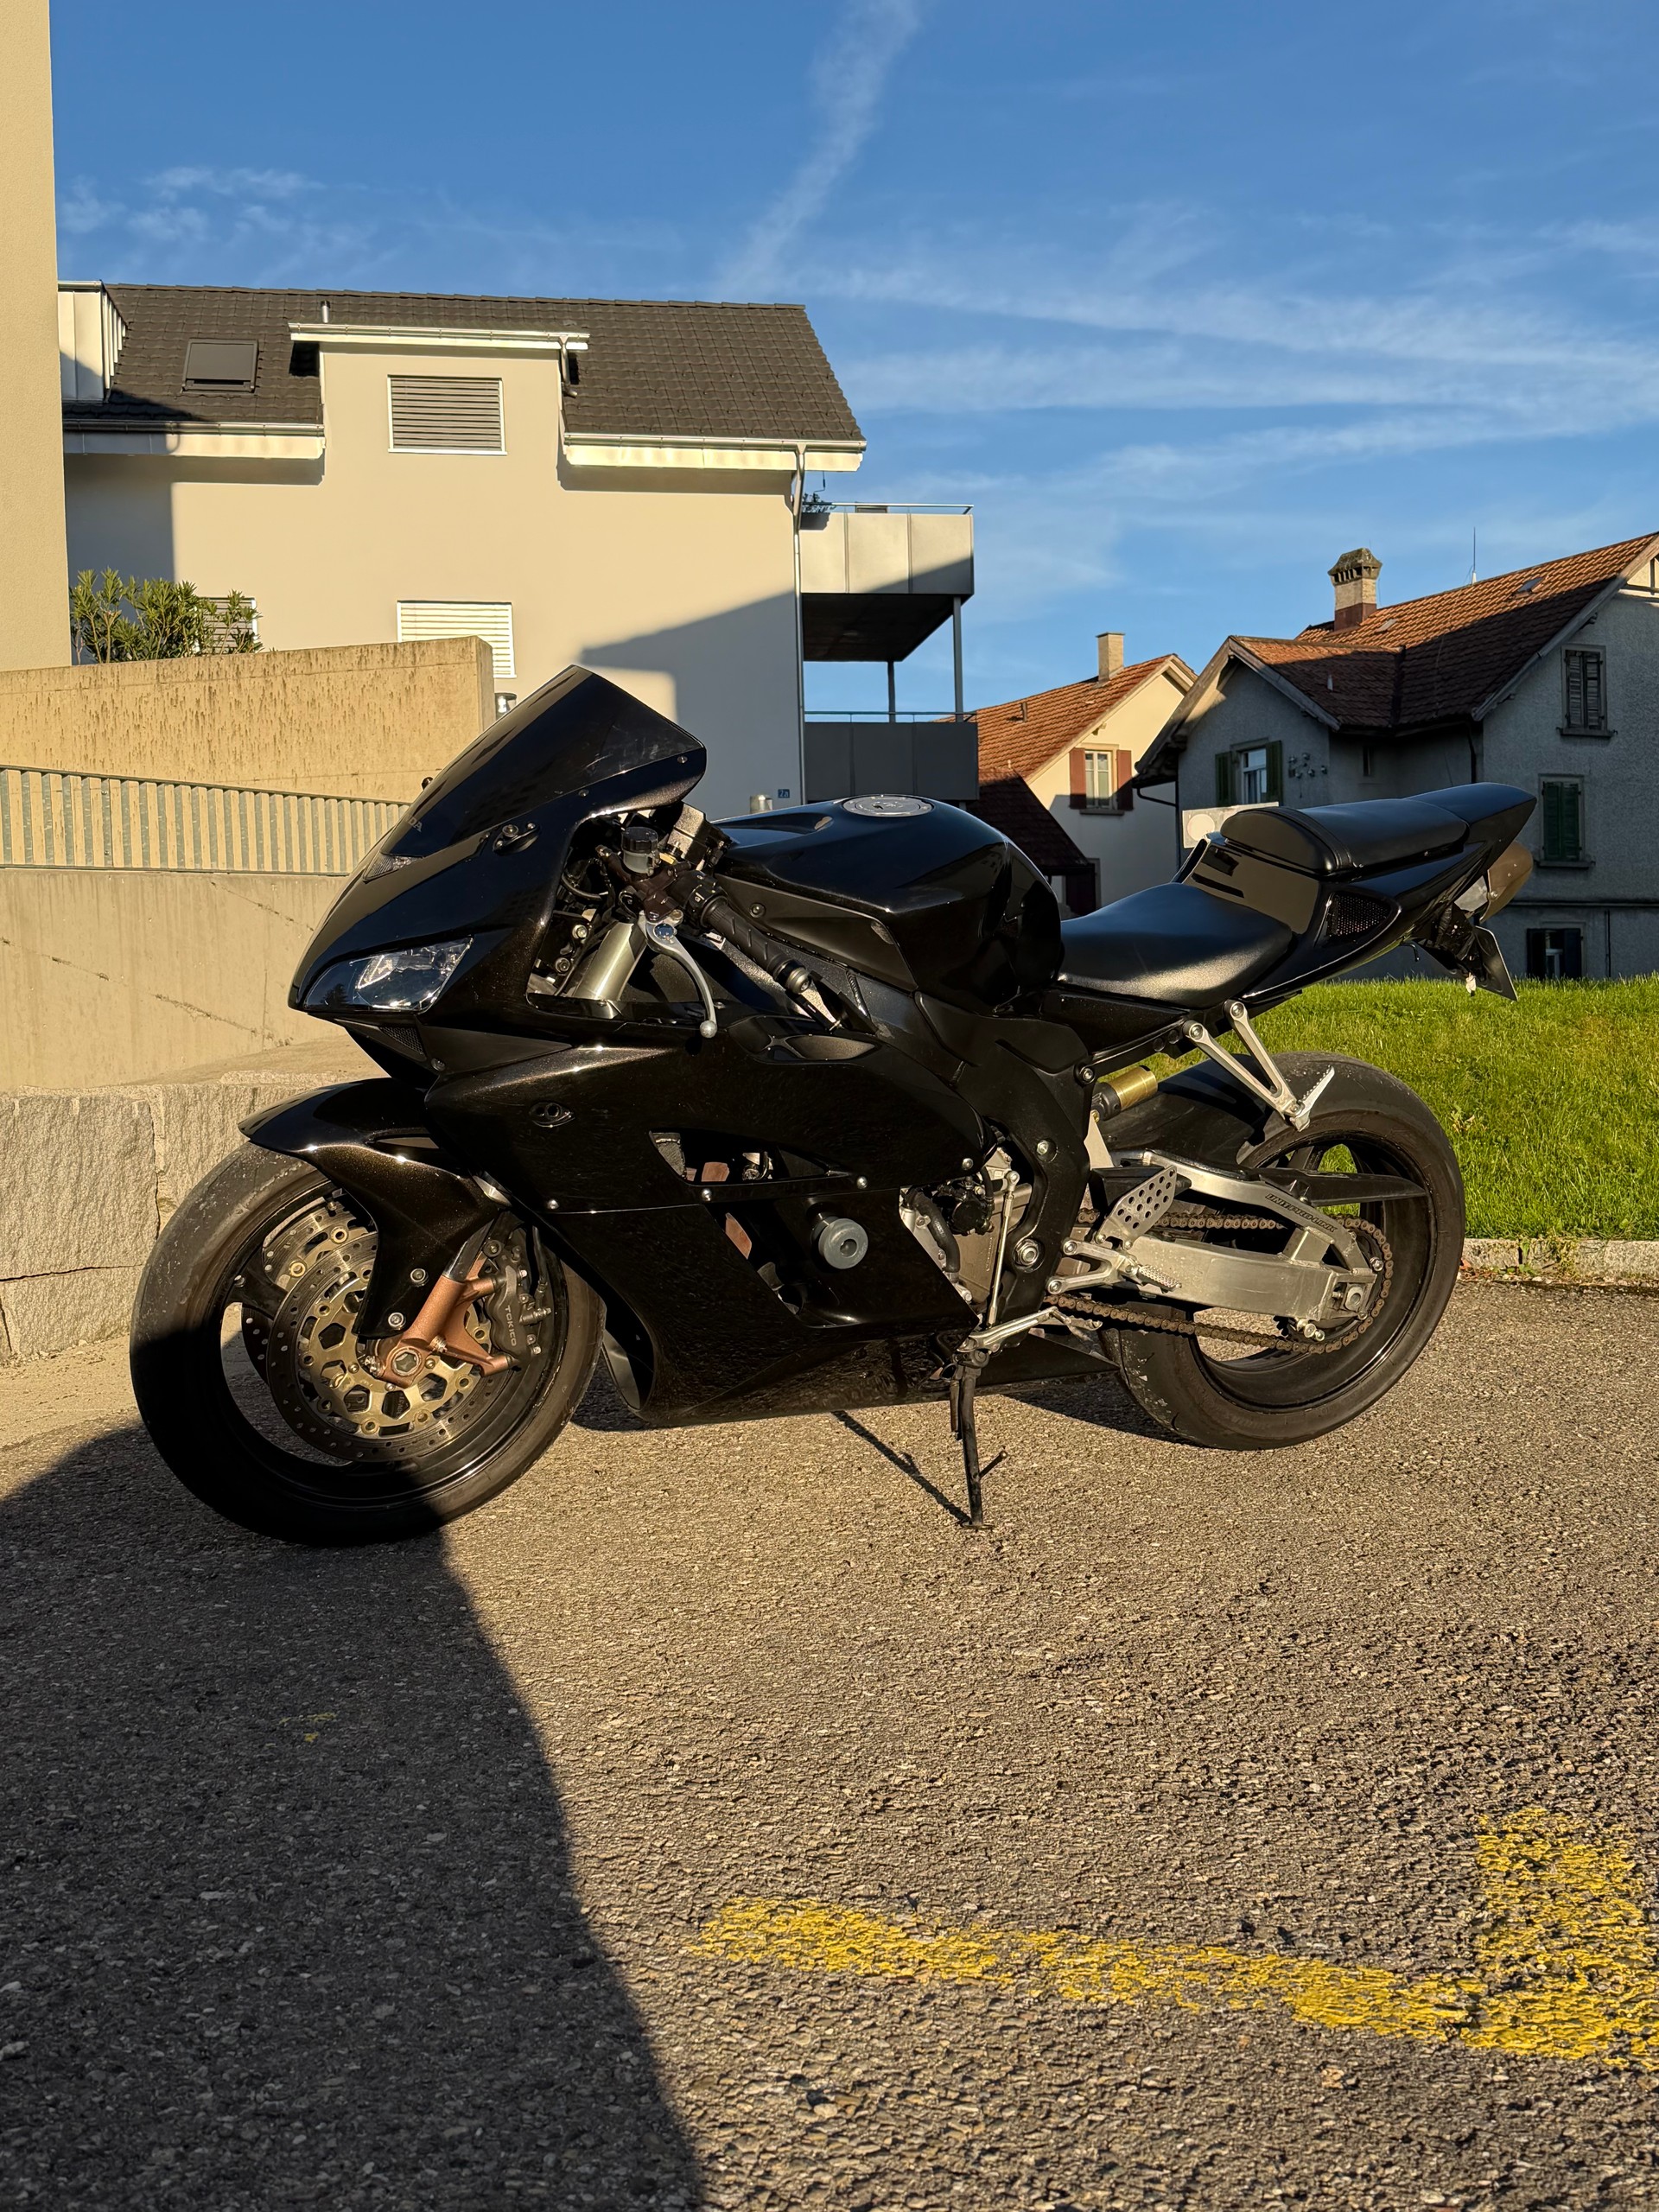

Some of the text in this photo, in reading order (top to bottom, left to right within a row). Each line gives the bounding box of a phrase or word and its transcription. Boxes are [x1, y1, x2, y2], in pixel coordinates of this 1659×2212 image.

[1265, 1193, 1338, 1232] UNIT PRO-LINK
[505, 1305, 517, 1346] TOKICO
